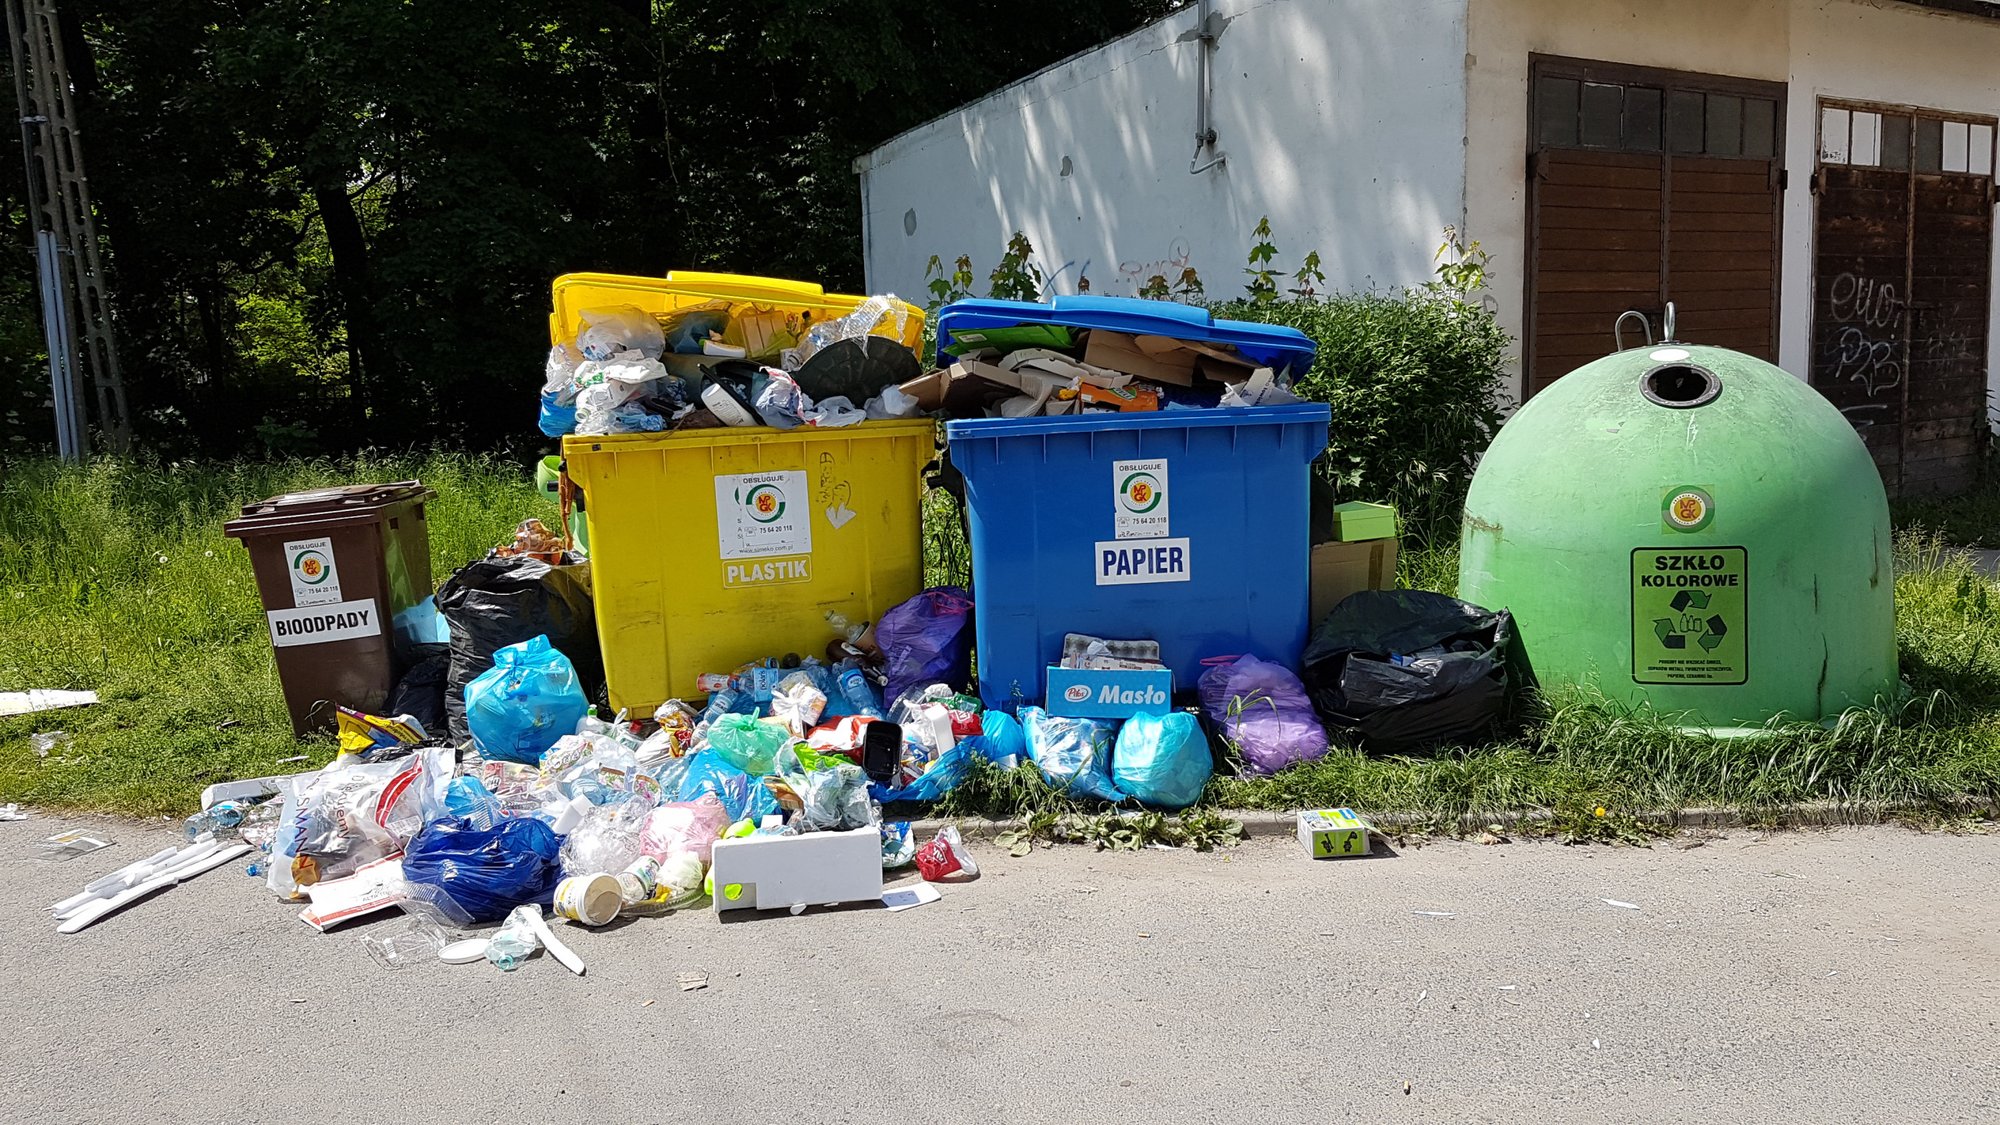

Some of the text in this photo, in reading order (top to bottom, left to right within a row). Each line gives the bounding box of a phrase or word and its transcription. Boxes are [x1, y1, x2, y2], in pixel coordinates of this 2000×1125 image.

[1118, 463, 1162, 472] OBSŁUGUJE
[742, 474, 785, 484] OBSŁUGUJE
[783, 524, 793, 532] 118
[289, 541, 327, 551] OBSŁUGUJE
[1102, 546, 1184, 576] PAPIER
[1655, 555, 1725, 571] SZKŁO
[727, 559, 808, 583] PLASTIK
[1641, 574, 1739, 587] KOLOROWE
[275, 610, 369, 637] BIOODPADY
[1097, 684, 1166, 705] Masło
